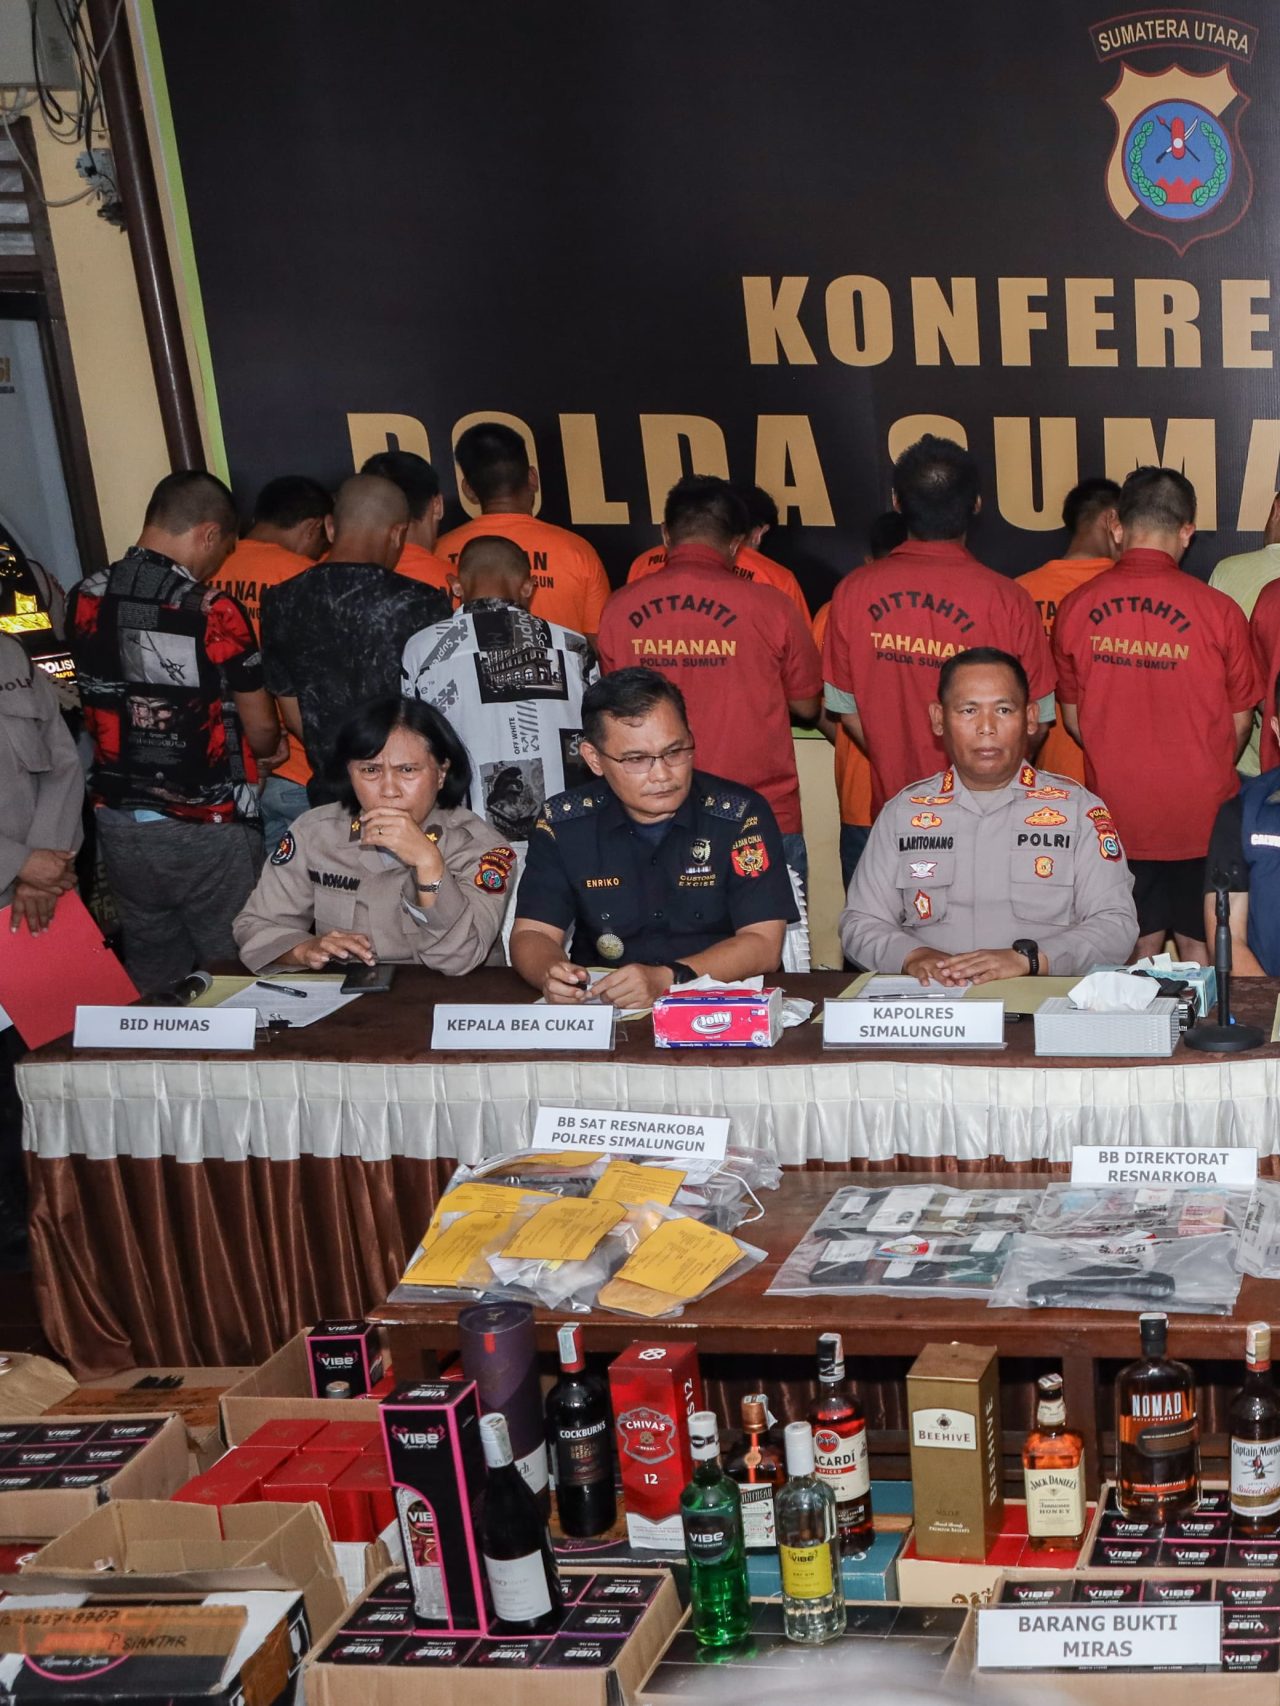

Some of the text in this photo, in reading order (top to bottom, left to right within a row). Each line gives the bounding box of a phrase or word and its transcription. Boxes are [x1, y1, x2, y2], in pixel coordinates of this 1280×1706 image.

[1098, 19, 1250, 54] SUMATERA UTARA
[628, 594, 738, 629] DITTAHTI
[868, 591, 977, 633] DITTAHTI
[1089, 596, 1193, 634] DITTAHTI
[631, 639, 737, 657] TAHANAN
[1090, 635, 1190, 660] TAHANAN
[640, 657, 728, 668] POLDA SUMUT
[876, 652, 914, 665] POLDA
[1093, 653, 1178, 672] POLDA SUMUT
[509, 717, 518, 739] WHITE
[1017, 833, 1070, 849] POLRI
[586, 878, 620, 888] ENRIKO
[699, 1011, 731, 1027] Jolly
[873, 1007, 954, 1020] KAPOLRES
[119, 1018, 210, 1032] BID HUMAS
[447, 1019, 595, 1032] KEPALA BEA CUKAI
[859, 1024, 966, 1039] SIMALUNGUN
[557, 1116, 705, 1137] BB SAT RESNARKOBA
[551, 1132, 706, 1152] POLRES SIMALUNGUN
[1099, 1151, 1229, 1166] BB DIREKTORAT
[1107, 1169, 1218, 1184] RESNARKOBA
[1132, 1393, 1182, 1417] NOMAD
[626, 1421, 666, 1432] CHIVAS
[918, 1430, 971, 1443] BEEHIVE
[985, 1396, 998, 1506] BEEHIVE
[1233, 1443, 1257, 1457] Captain
[815, 1452, 855, 1467] ACARDÍ
[644, 1474, 659, 1485] 12
[1030, 1477, 1048, 1491] JACK
[1236, 1485, 1262, 1495] Spiced
[1019, 1615, 1178, 1632] BARANG BUKTI
[1063, 1641, 1133, 1657] MIRAS
